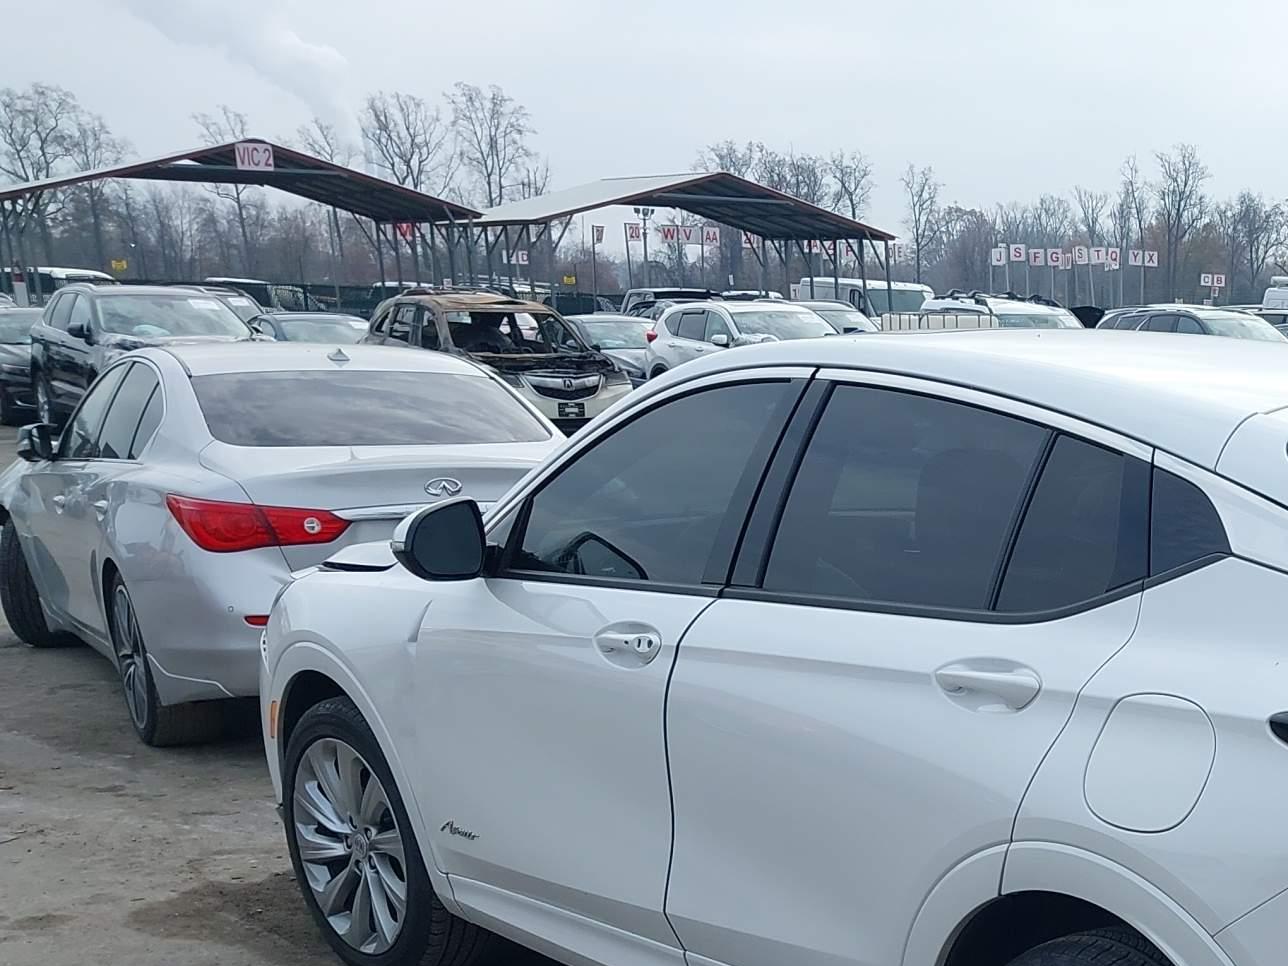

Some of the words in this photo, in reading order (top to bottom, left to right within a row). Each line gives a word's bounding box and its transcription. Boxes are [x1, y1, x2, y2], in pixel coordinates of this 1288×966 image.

[236, 146, 260, 166] VIC
[263, 148, 272, 167] 2
[628, 226, 640, 239] 20
[663, 227, 676, 240] W
[683, 229, 692, 240] V
[705, 230, 718, 242] AA
[996, 250, 1002, 262] J
[1013, 247, 1022, 258] S
[1033, 251, 1041, 263] F
[1050, 251, 1060, 263] G
[1077, 248, 1083, 259] S
[1094, 249, 1102, 261] T
[1110, 250, 1118, 262] Q
[1132, 251, 1140, 262] Y
[1147, 253, 1155, 264] X
